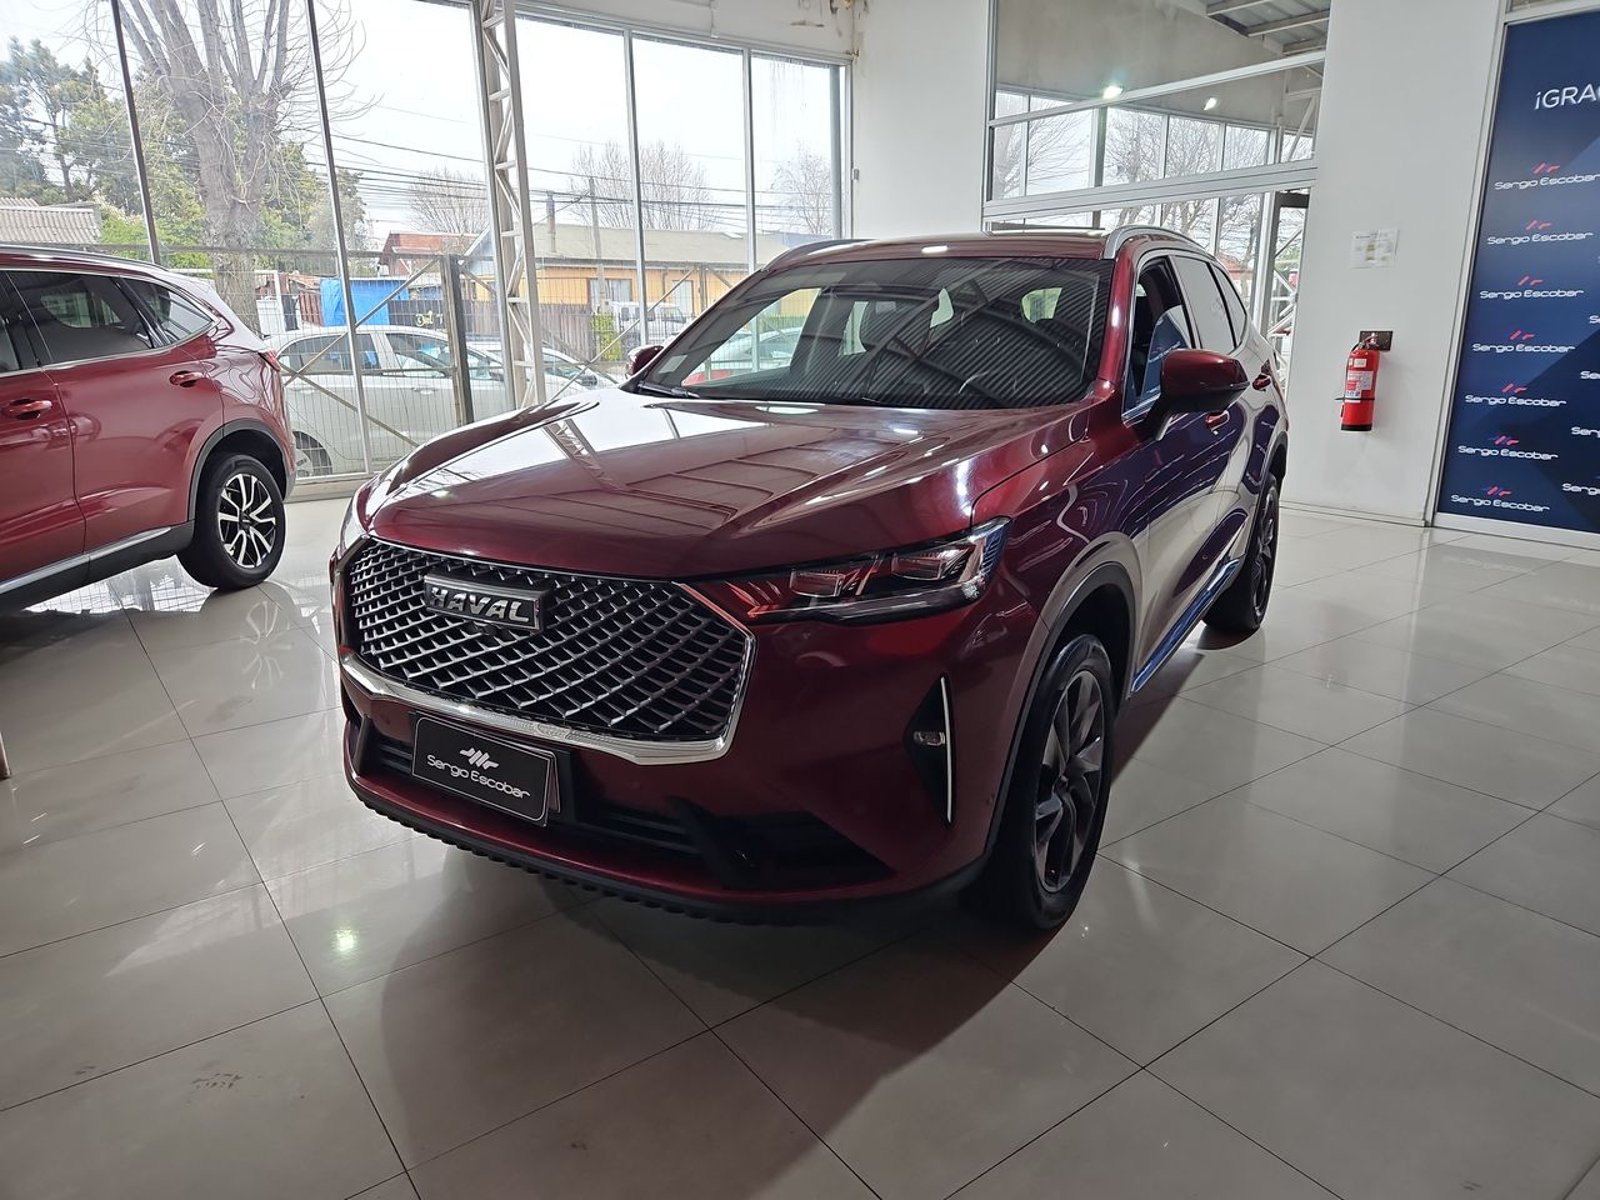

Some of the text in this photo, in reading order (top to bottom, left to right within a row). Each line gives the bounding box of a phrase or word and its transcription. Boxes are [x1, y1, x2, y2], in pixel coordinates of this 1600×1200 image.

[1539, 173, 1600, 186] Escobar
[1532, 231, 1594, 241] Escobar
[1524, 288, 1584, 298] Escobar
[1516, 342, 1575, 352] Escobar
[1508, 395, 1567, 407] Escobar
[1500, 448, 1559, 460] Escobar
[1493, 499, 1551, 512] Escobar
[429, 586, 529, 622] HAVAL
[470, 770, 531, 798] Escobar
